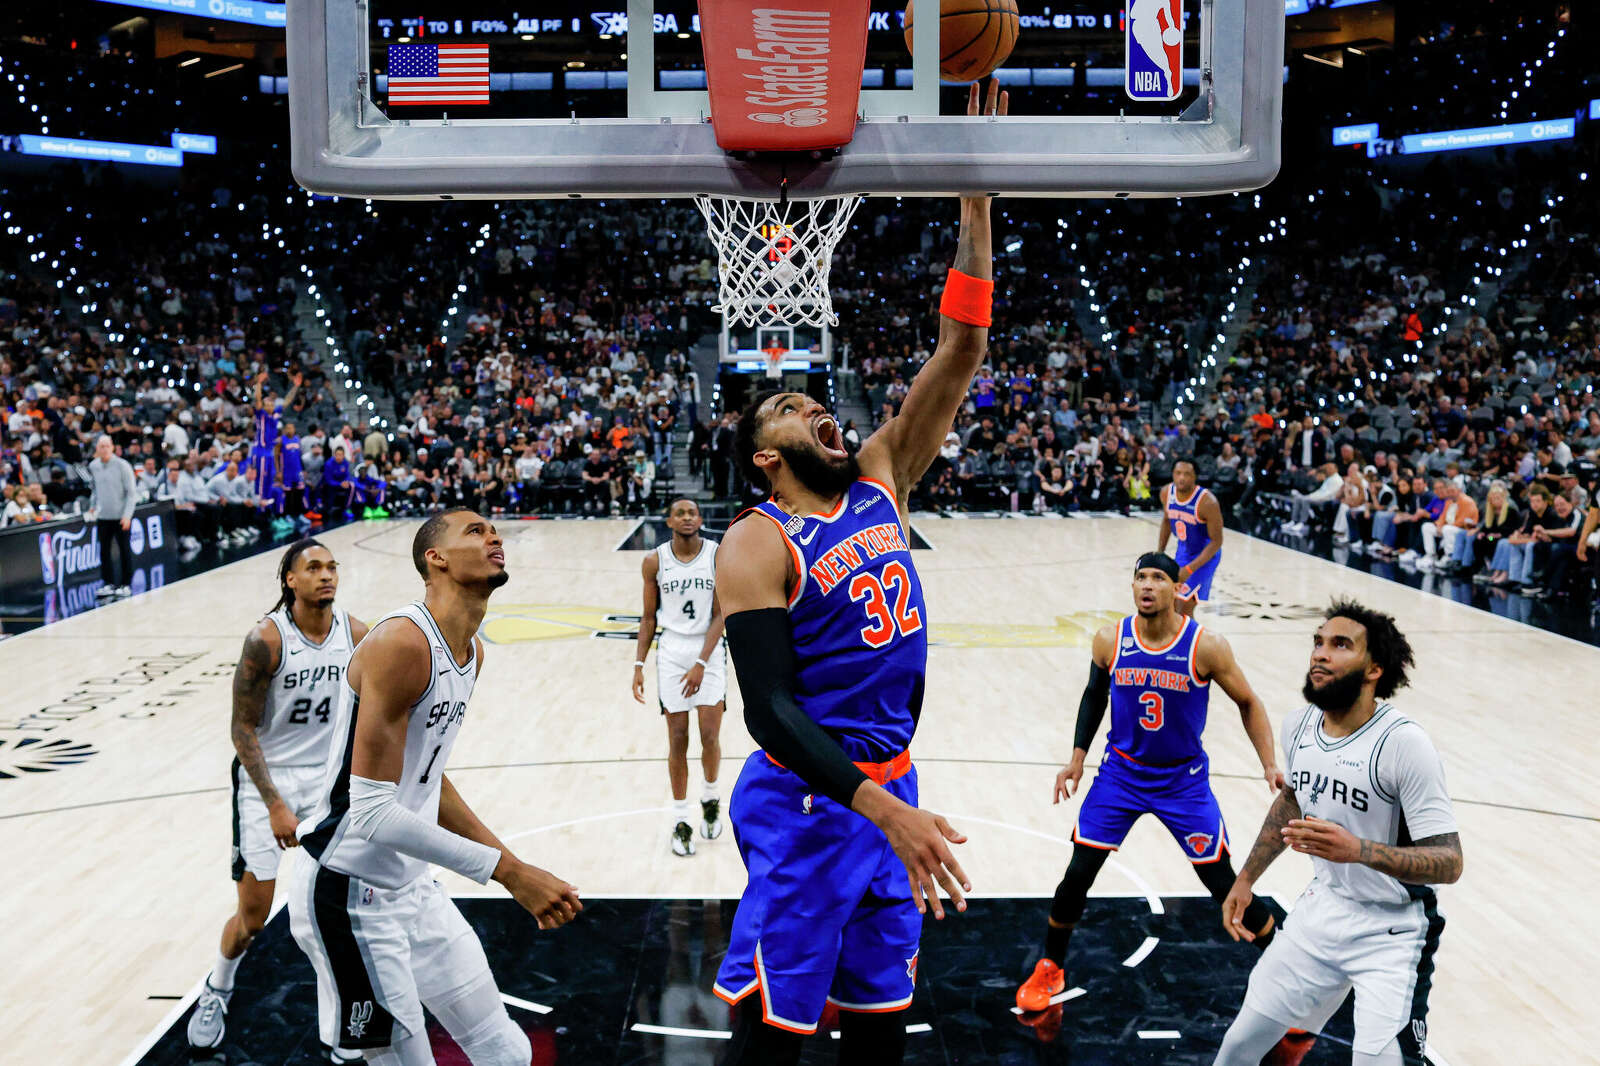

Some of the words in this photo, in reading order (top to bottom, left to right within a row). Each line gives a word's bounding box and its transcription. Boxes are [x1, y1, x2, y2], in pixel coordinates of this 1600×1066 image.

[1134, 71, 1161, 92] NBA
[809, 538, 864, 597] NEW
[853, 523, 908, 560] YORK
[661, 577, 714, 595] SPURS
[682, 600, 696, 619] 4
[848, 560, 923, 648] 32
[1115, 667, 1148, 686] NEW
[1149, 668, 1191, 692] YORK
[289, 696, 331, 724] 24
[1139, 691, 1164, 731] 3
[419, 745, 441, 784] 1
